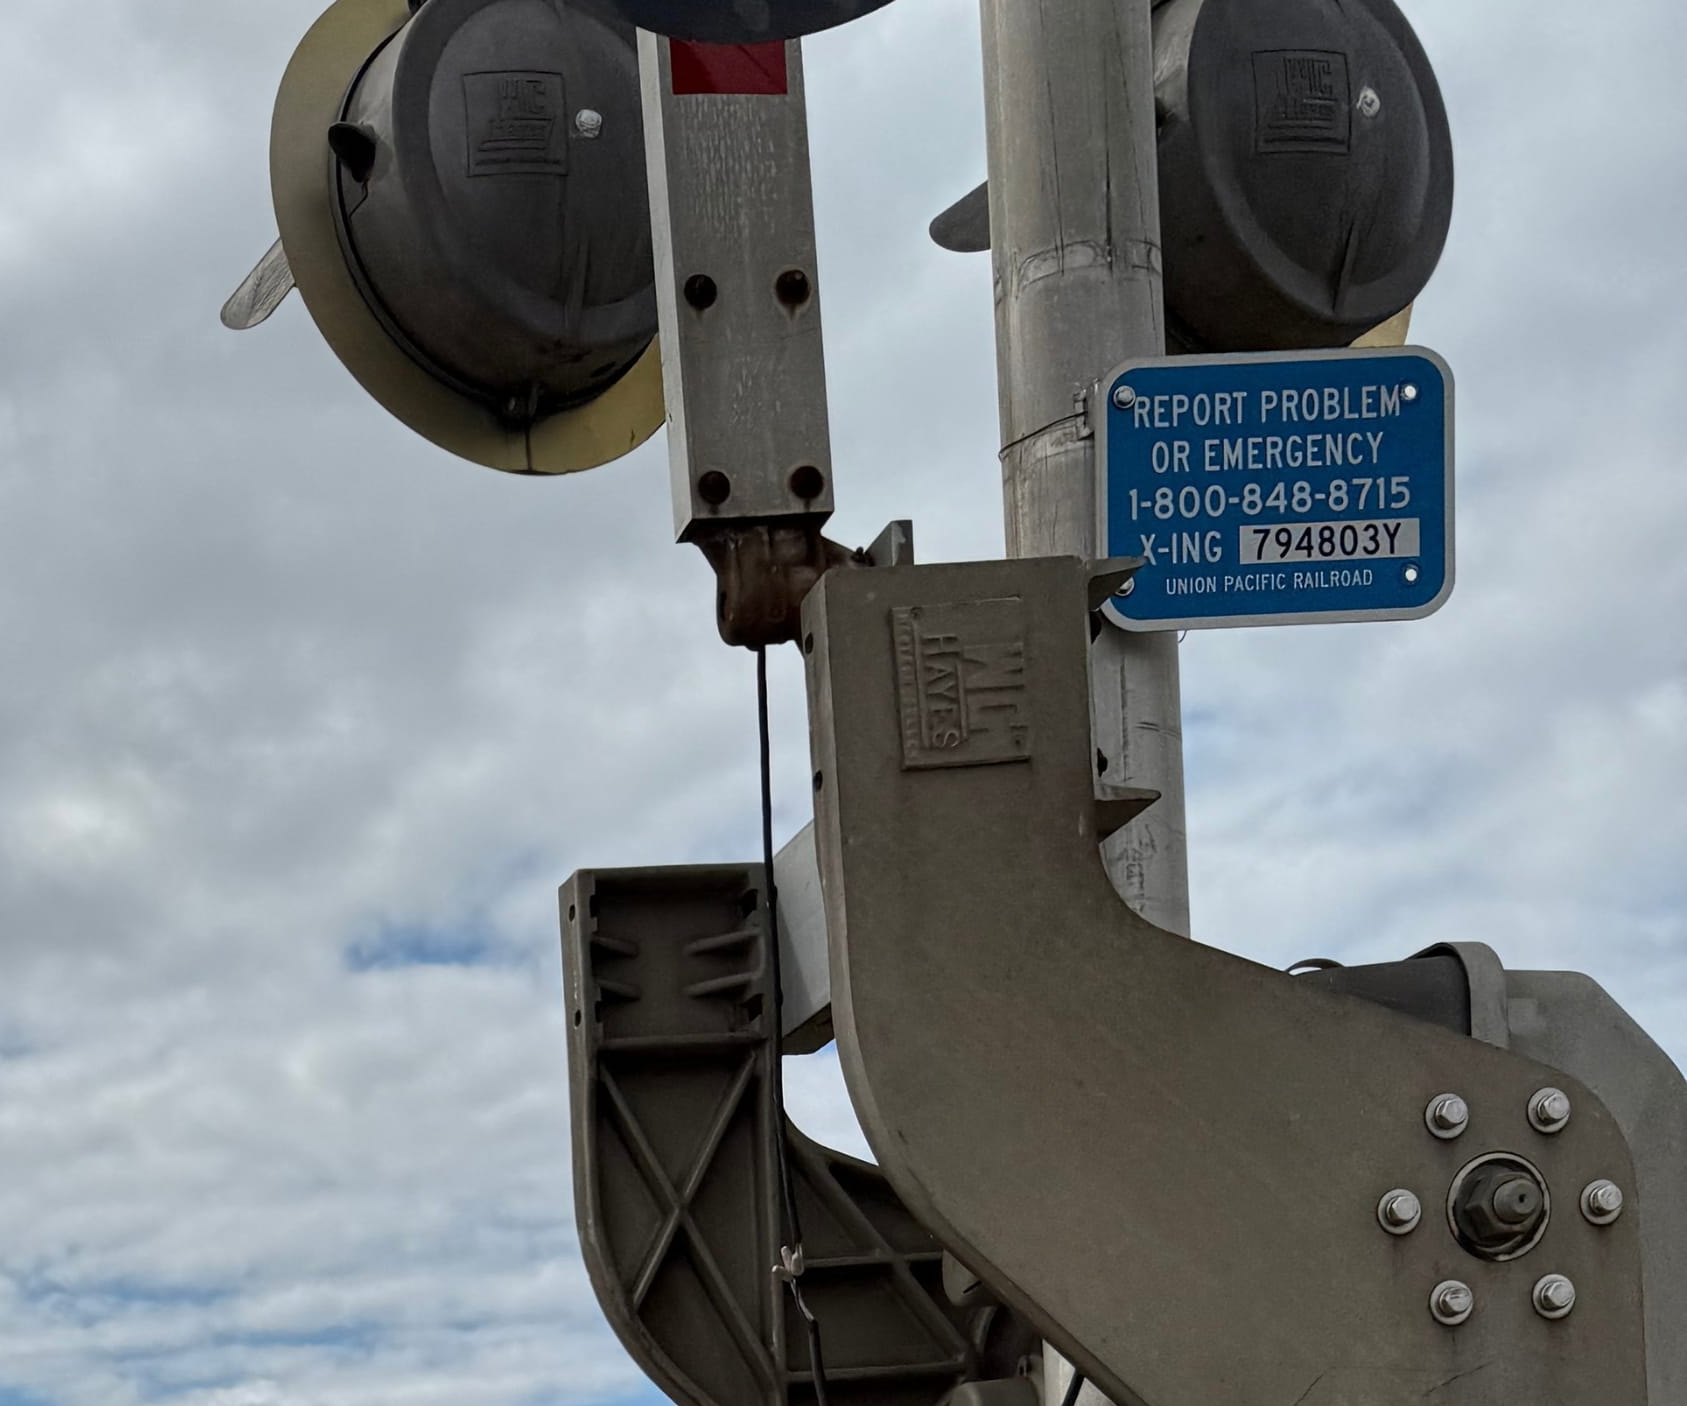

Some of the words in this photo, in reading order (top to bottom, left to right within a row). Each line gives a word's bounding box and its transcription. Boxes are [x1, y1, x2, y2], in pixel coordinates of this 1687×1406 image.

[1133, 390, 1248, 429] REPORT
[1260, 384, 1401, 424] PROBLEM
[1151, 440, 1190, 474] OR
[1204, 431, 1384, 472] EMERGENCY
[1128, 476, 1411, 521] 1-800-848-8715
[1140, 531, 1223, 566] X-ING
[1252, 522, 1402, 561] 794803Y
[1165, 576, 1217, 595] UNION
[1224, 572, 1287, 593] PACIFIC
[1293, 569, 1374, 590] RAILROAD
